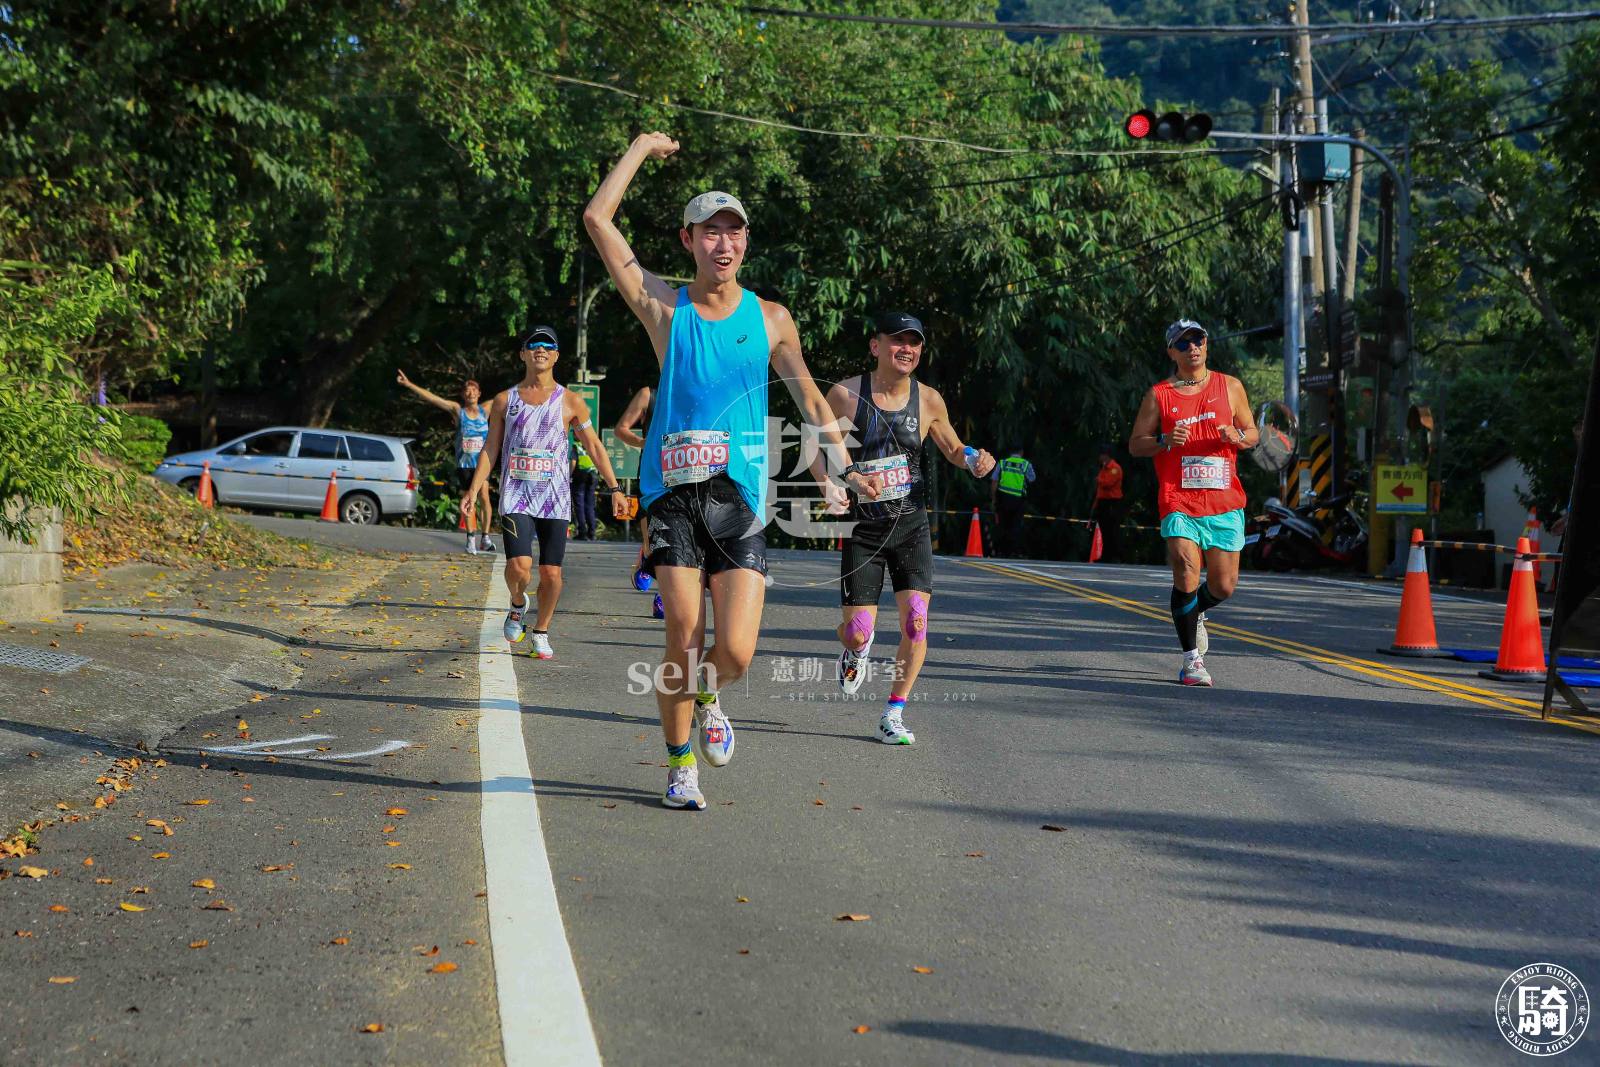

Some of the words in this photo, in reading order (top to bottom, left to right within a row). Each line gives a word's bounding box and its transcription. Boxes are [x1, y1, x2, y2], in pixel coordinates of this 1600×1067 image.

[663, 446, 727, 469] 10009
[512, 458, 552, 471] 10189
[1183, 466, 1223, 478] 10308
